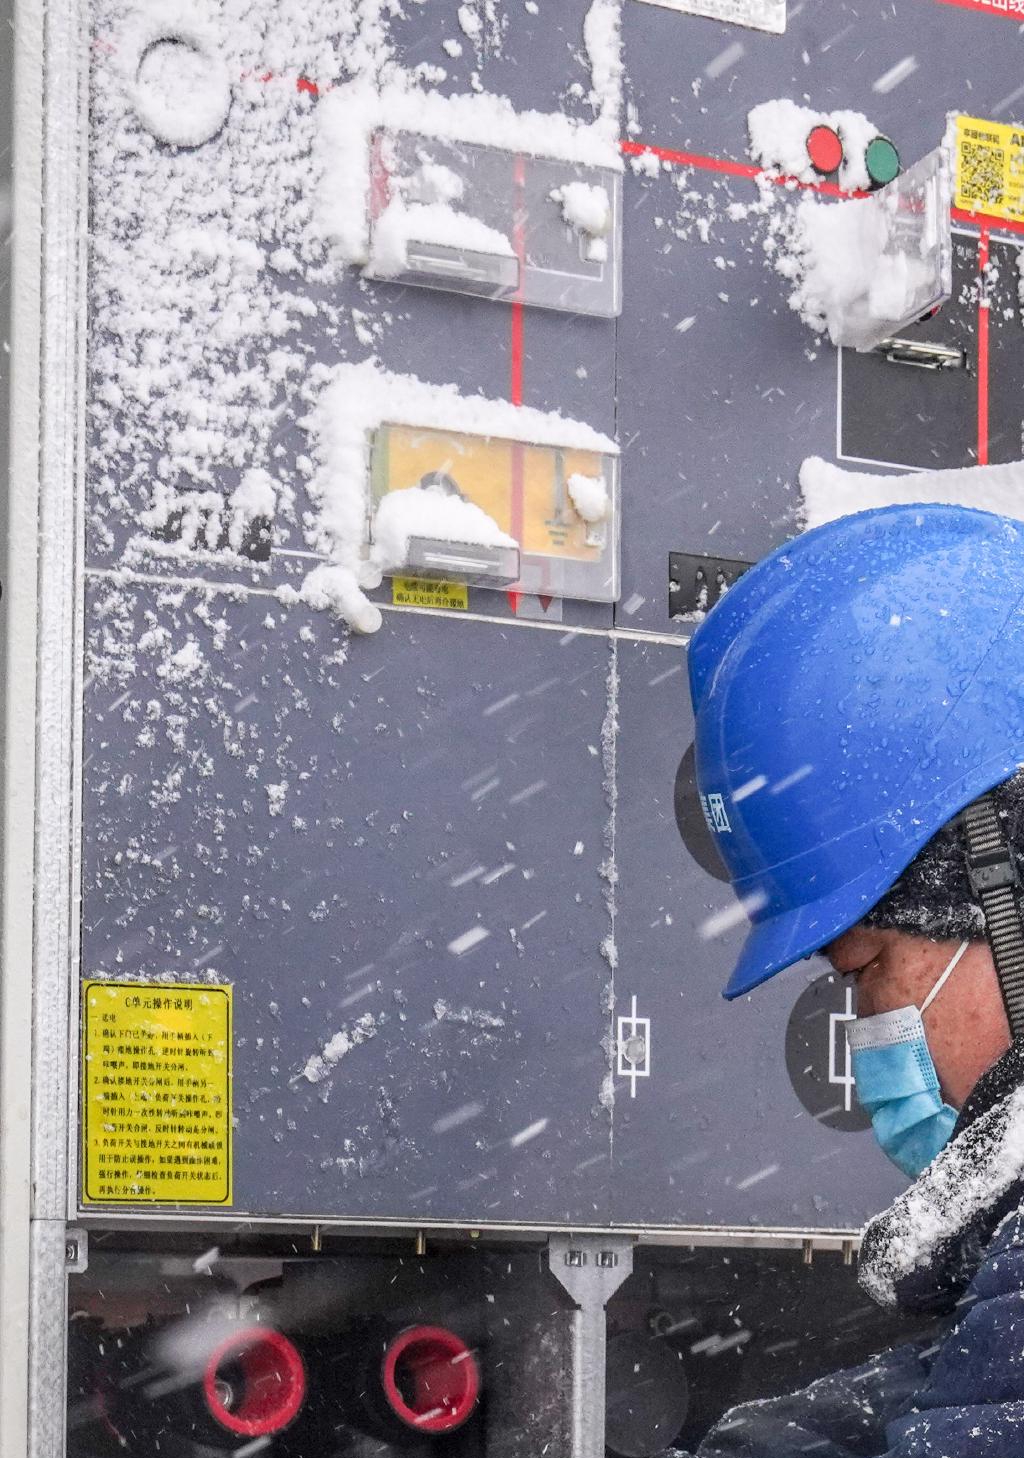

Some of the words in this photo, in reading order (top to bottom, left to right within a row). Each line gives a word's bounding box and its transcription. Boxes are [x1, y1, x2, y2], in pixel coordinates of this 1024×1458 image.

[125, 996, 193, 1011] C单元操作说明
